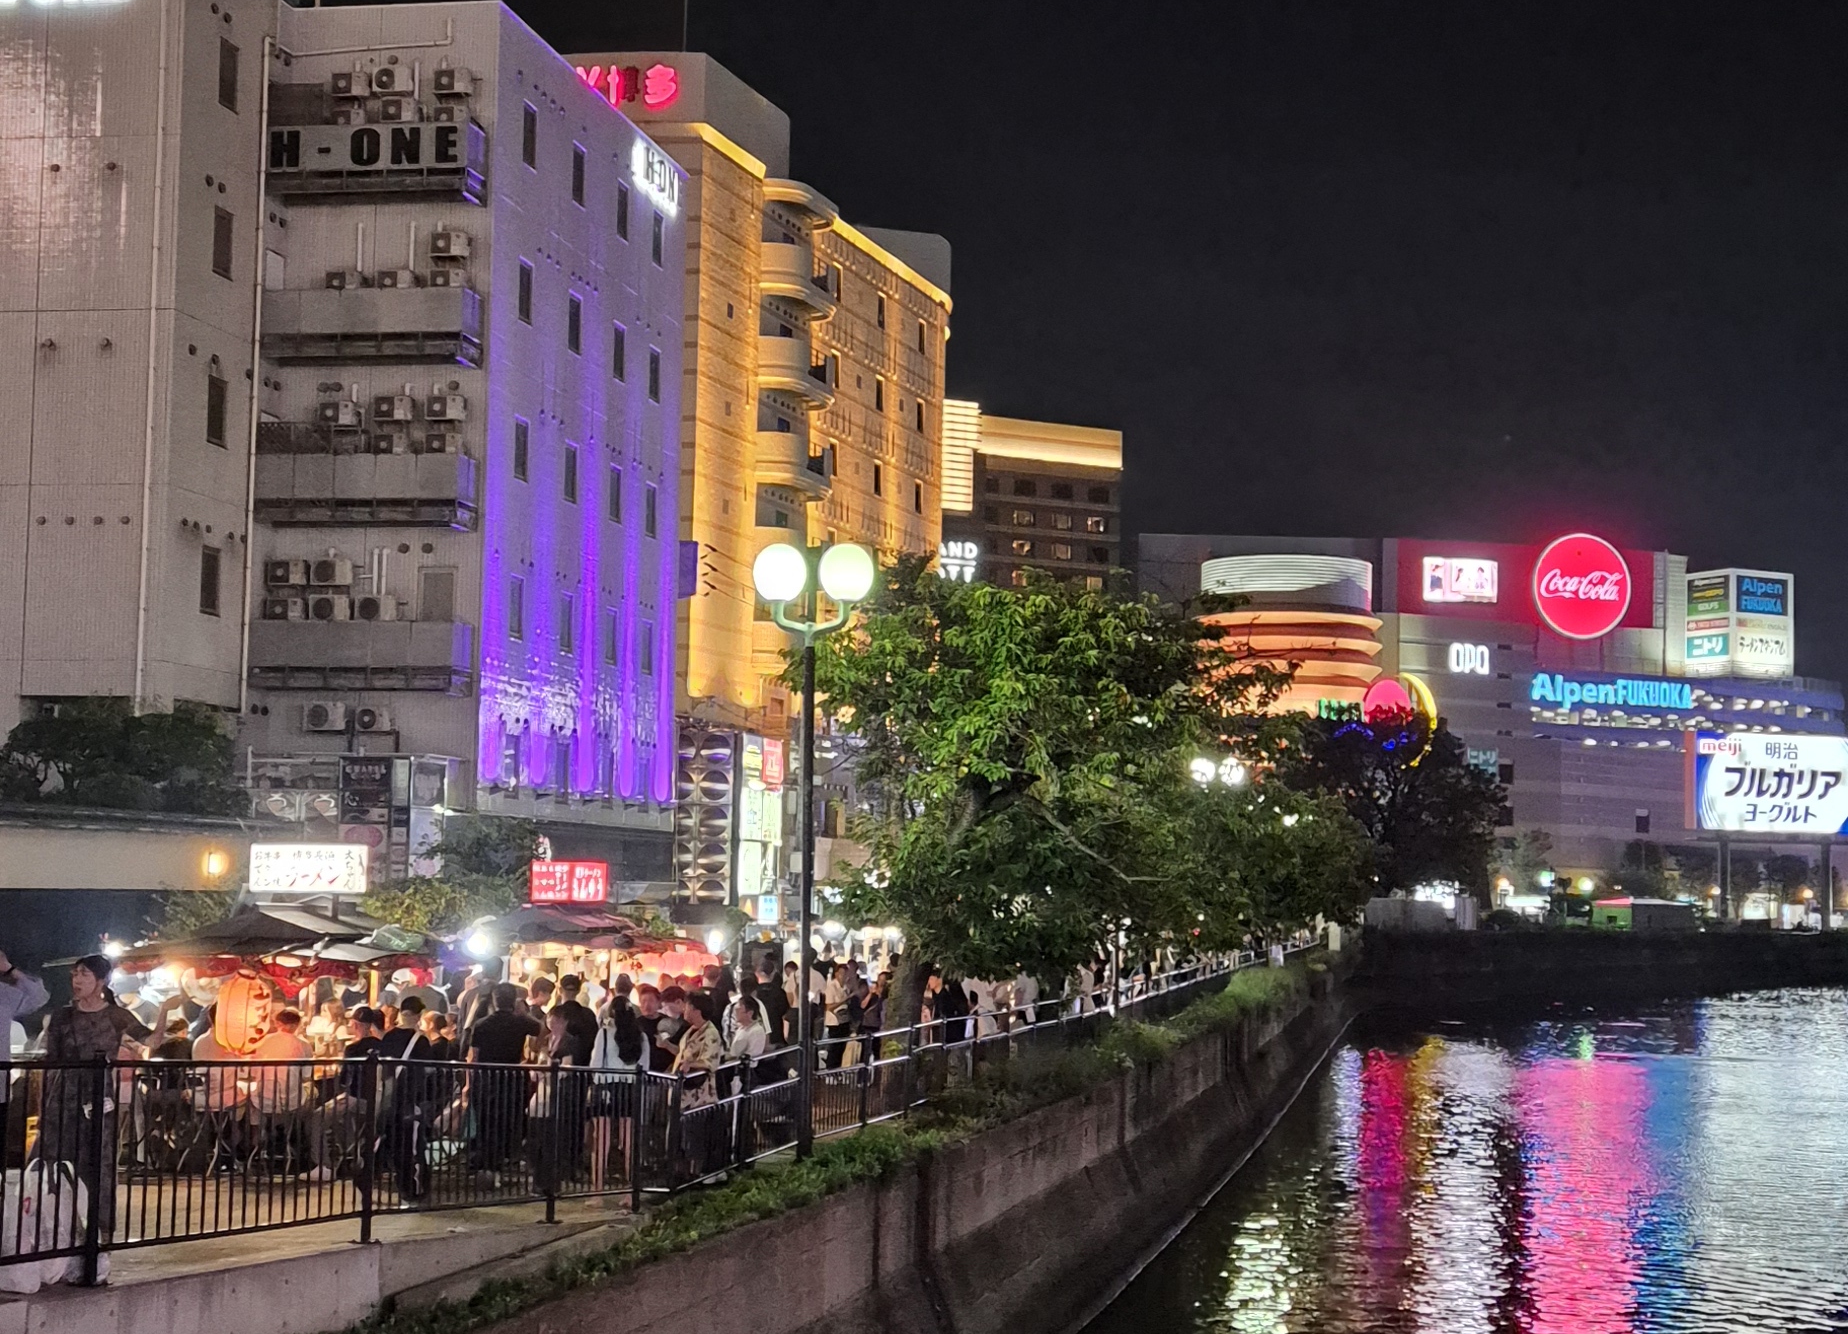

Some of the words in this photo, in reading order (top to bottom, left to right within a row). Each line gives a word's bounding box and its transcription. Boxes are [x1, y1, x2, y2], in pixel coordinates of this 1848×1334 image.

[269, 125, 459, 168] H-ONE
[1540, 568, 1624, 601] Coca-Cola
[1742, 577, 1783, 596] Alpen
[1692, 636, 1724, 657] ニトリ
[1531, 672, 1617, 709] Alpen
[1616, 679, 1693, 709] FUKUOKA
[1702, 738, 1742, 756] meiji
[1765, 742, 1799, 760] 明治
[1724, 761, 1842, 800] ブルガリア
[1744, 802, 1817, 823] ヨーグルト
